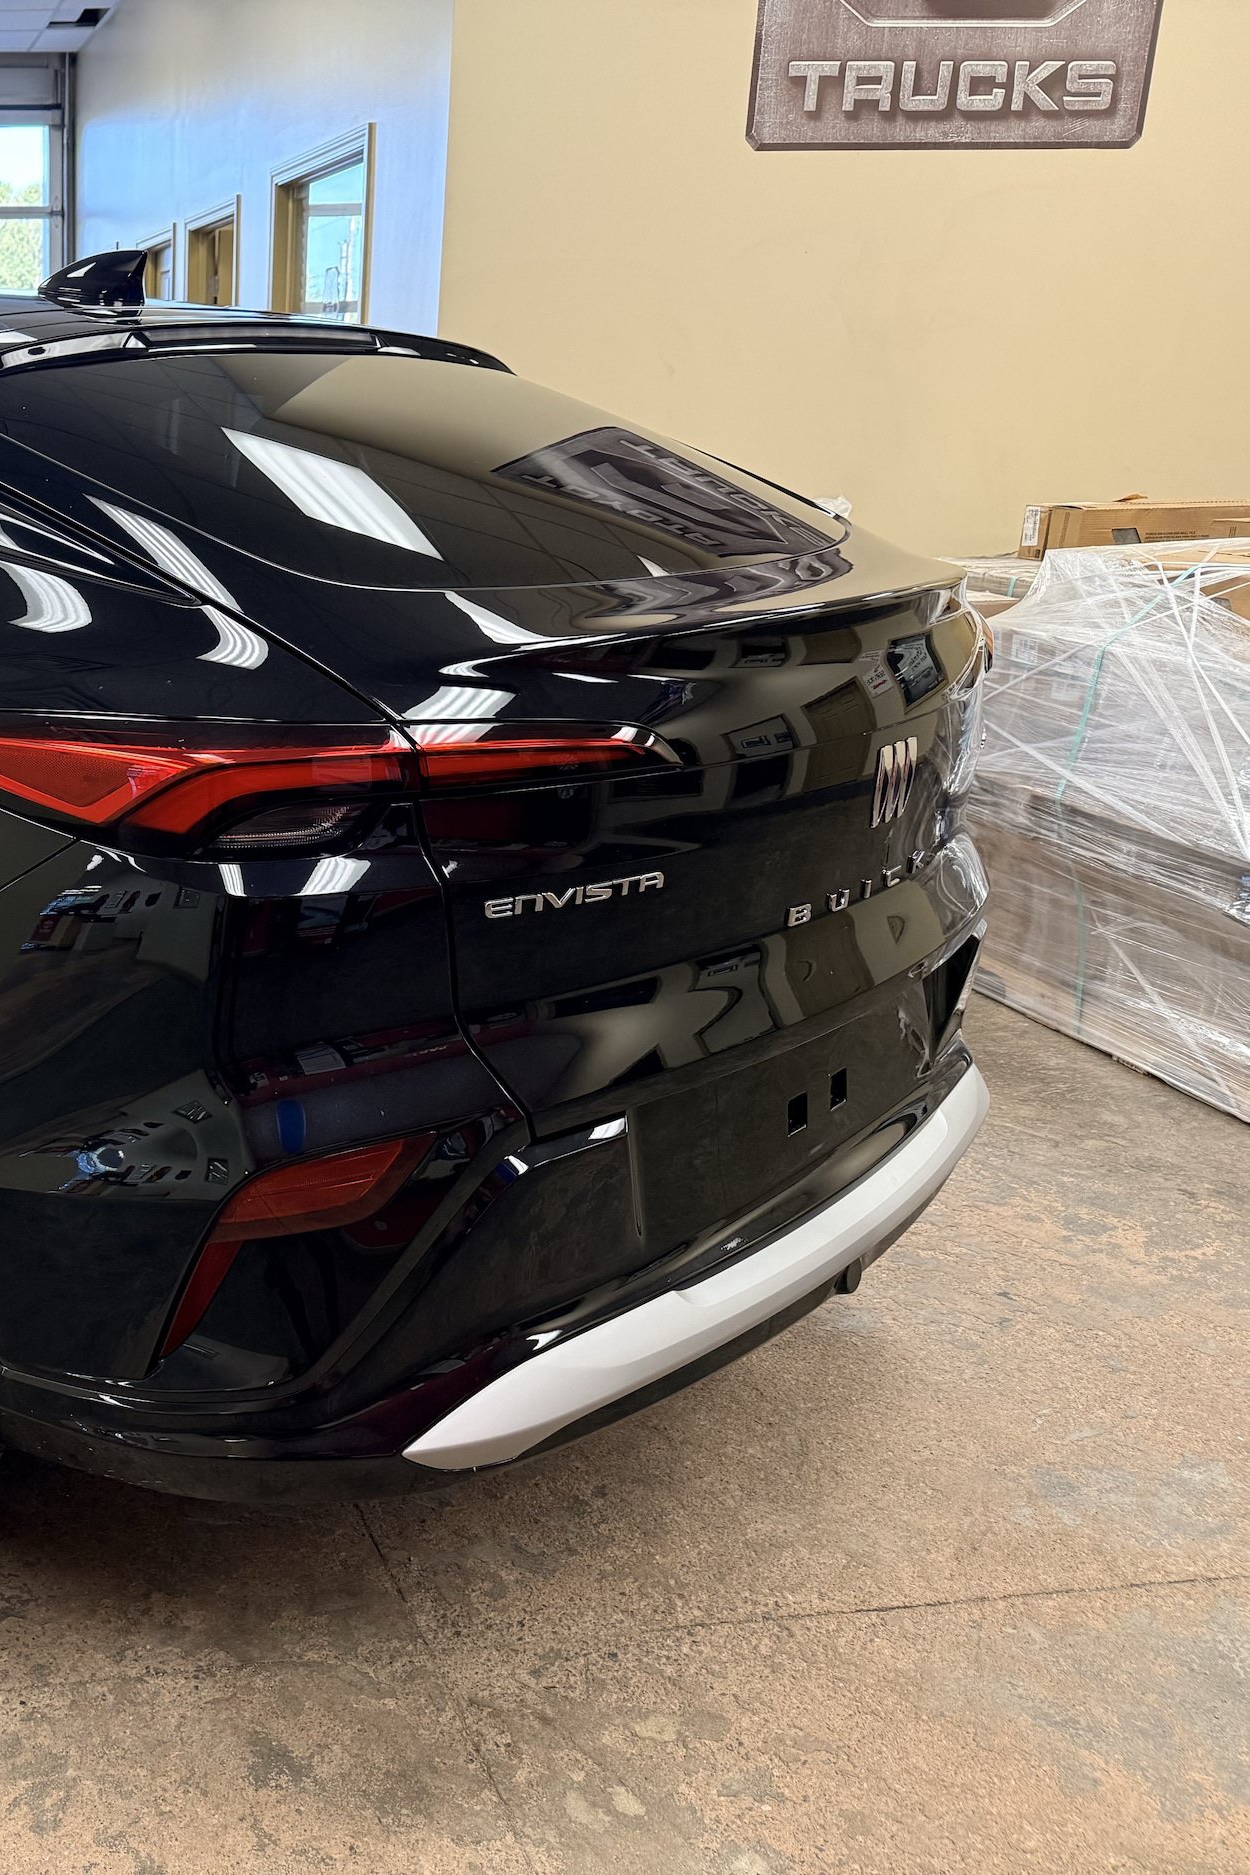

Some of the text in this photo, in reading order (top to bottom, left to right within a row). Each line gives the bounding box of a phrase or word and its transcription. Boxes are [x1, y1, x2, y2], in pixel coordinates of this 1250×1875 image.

[788, 60, 1117, 112] TRUCKS
[484, 871, 665, 919] ENVISTA
[787, 850, 925, 928] BUICK
